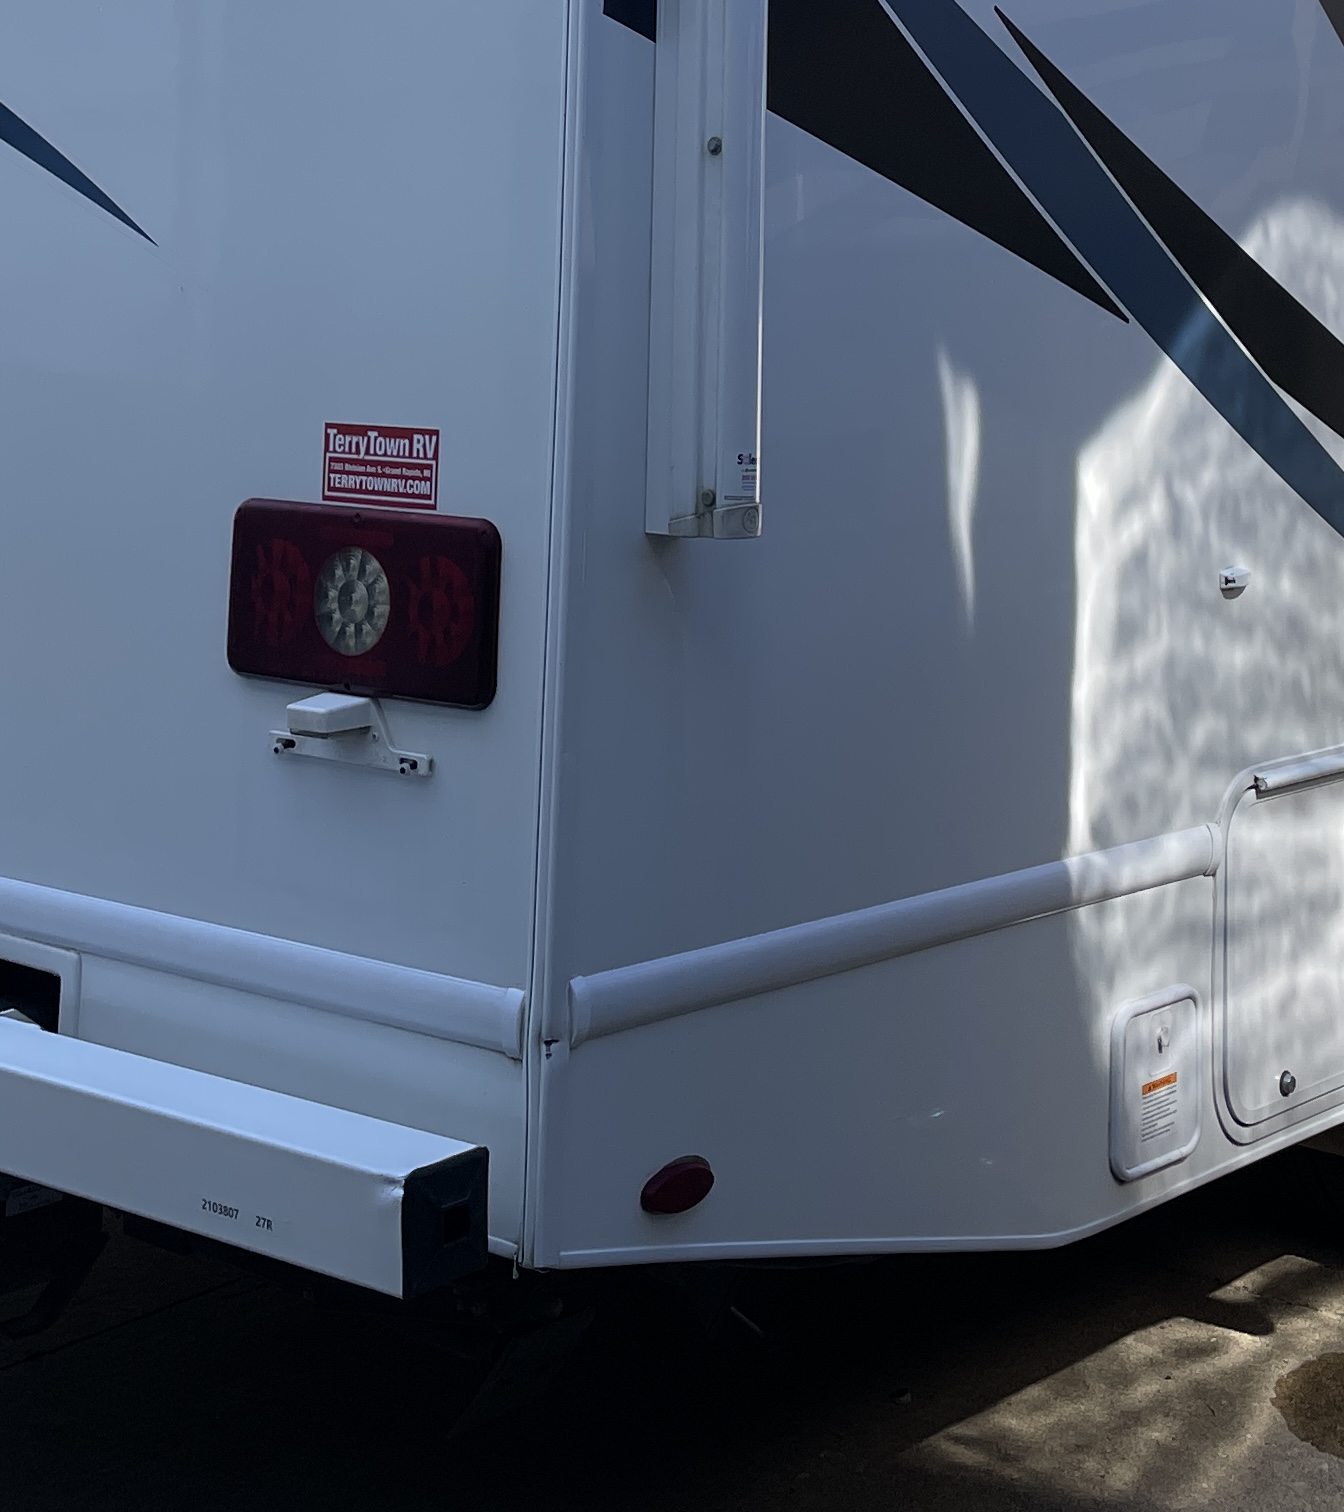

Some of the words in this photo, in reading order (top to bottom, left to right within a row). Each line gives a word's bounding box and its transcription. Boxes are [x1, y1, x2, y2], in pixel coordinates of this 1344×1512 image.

[327, 428, 410, 459] TerryTown
[412, 433, 437, 459] RV
[329, 473, 431, 495] TERRYTOWNRV.COM
[201, 1198, 240, 1220] 2103807
